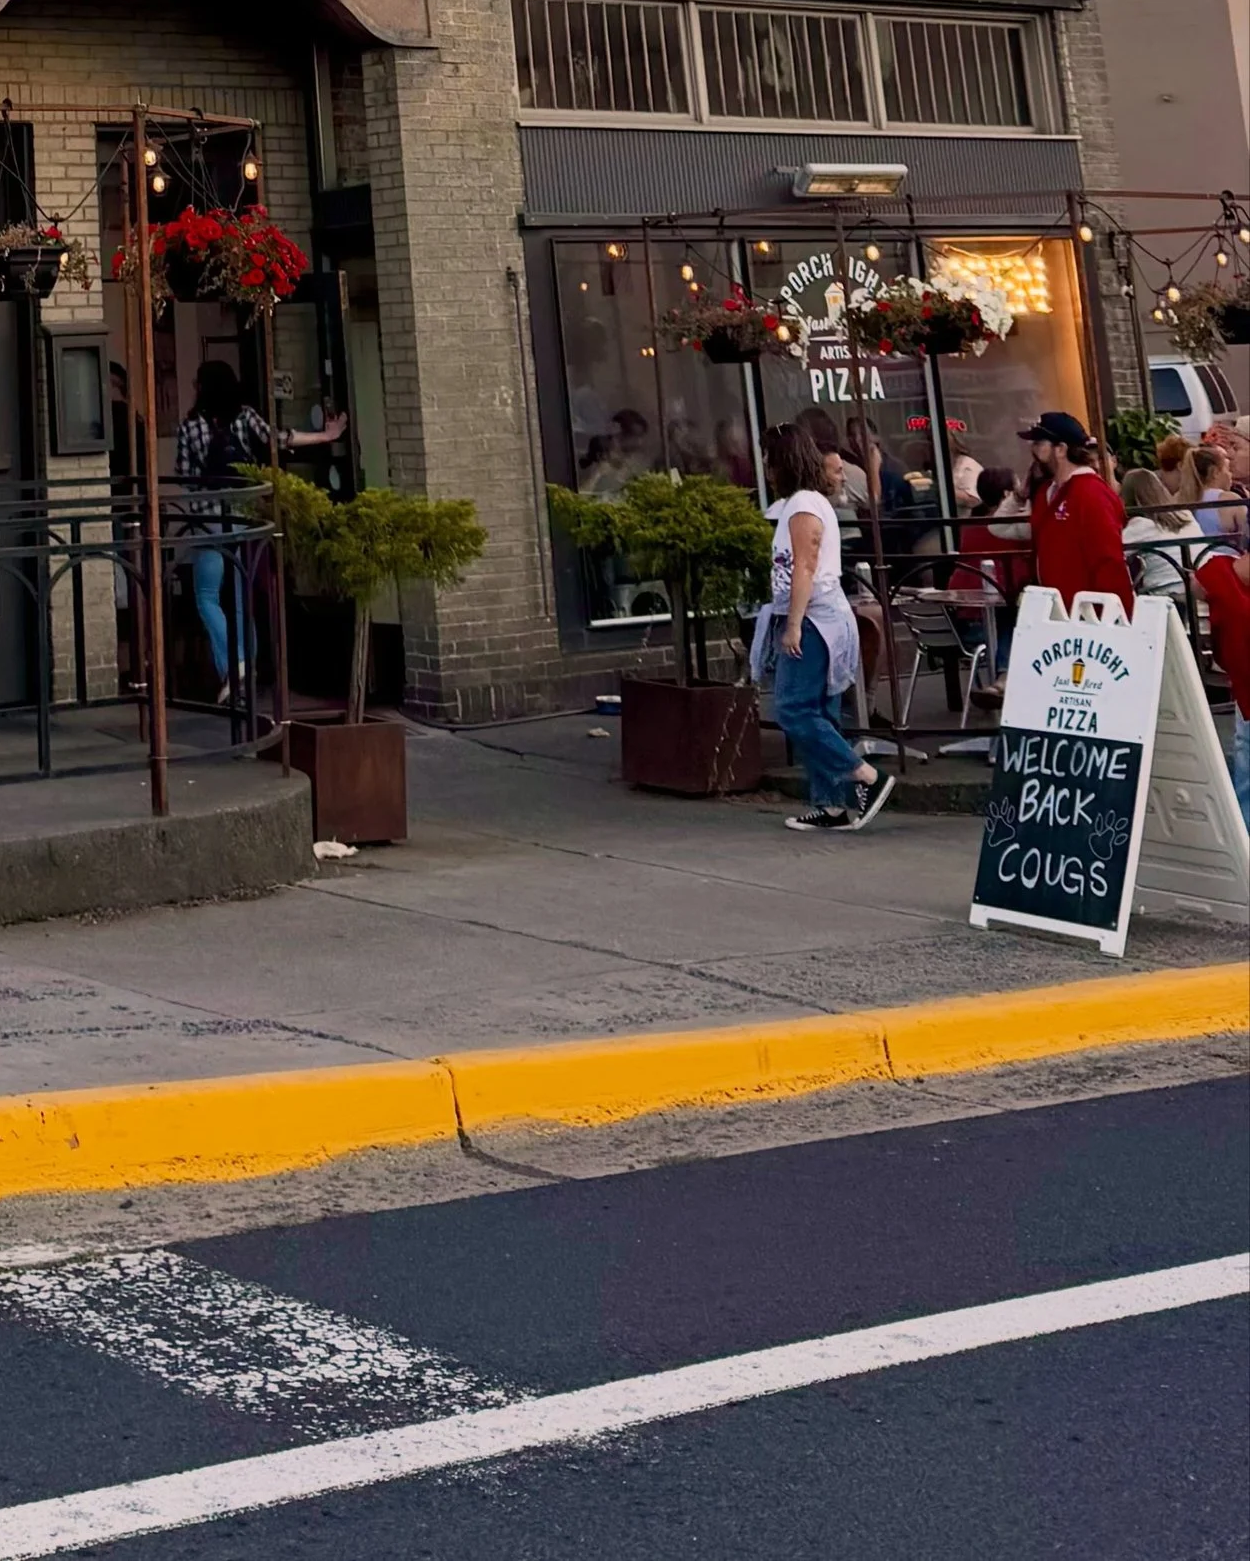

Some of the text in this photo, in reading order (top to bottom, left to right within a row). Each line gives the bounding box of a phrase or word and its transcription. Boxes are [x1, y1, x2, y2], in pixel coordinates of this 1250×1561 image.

[780, 252, 890, 313] PORCH IGHT
[1031, 638, 1129, 681] PORCH LIGHT
[1052, 675, 1103, 690] fast fired
[1058, 696, 1092, 707] ARTISAN
[1046, 706, 1098, 734] PIZZA
[1002, 733, 1131, 781] WELCOME
[1018, 778, 1096, 827] BACK
[998, 842, 1108, 898] COUGS
